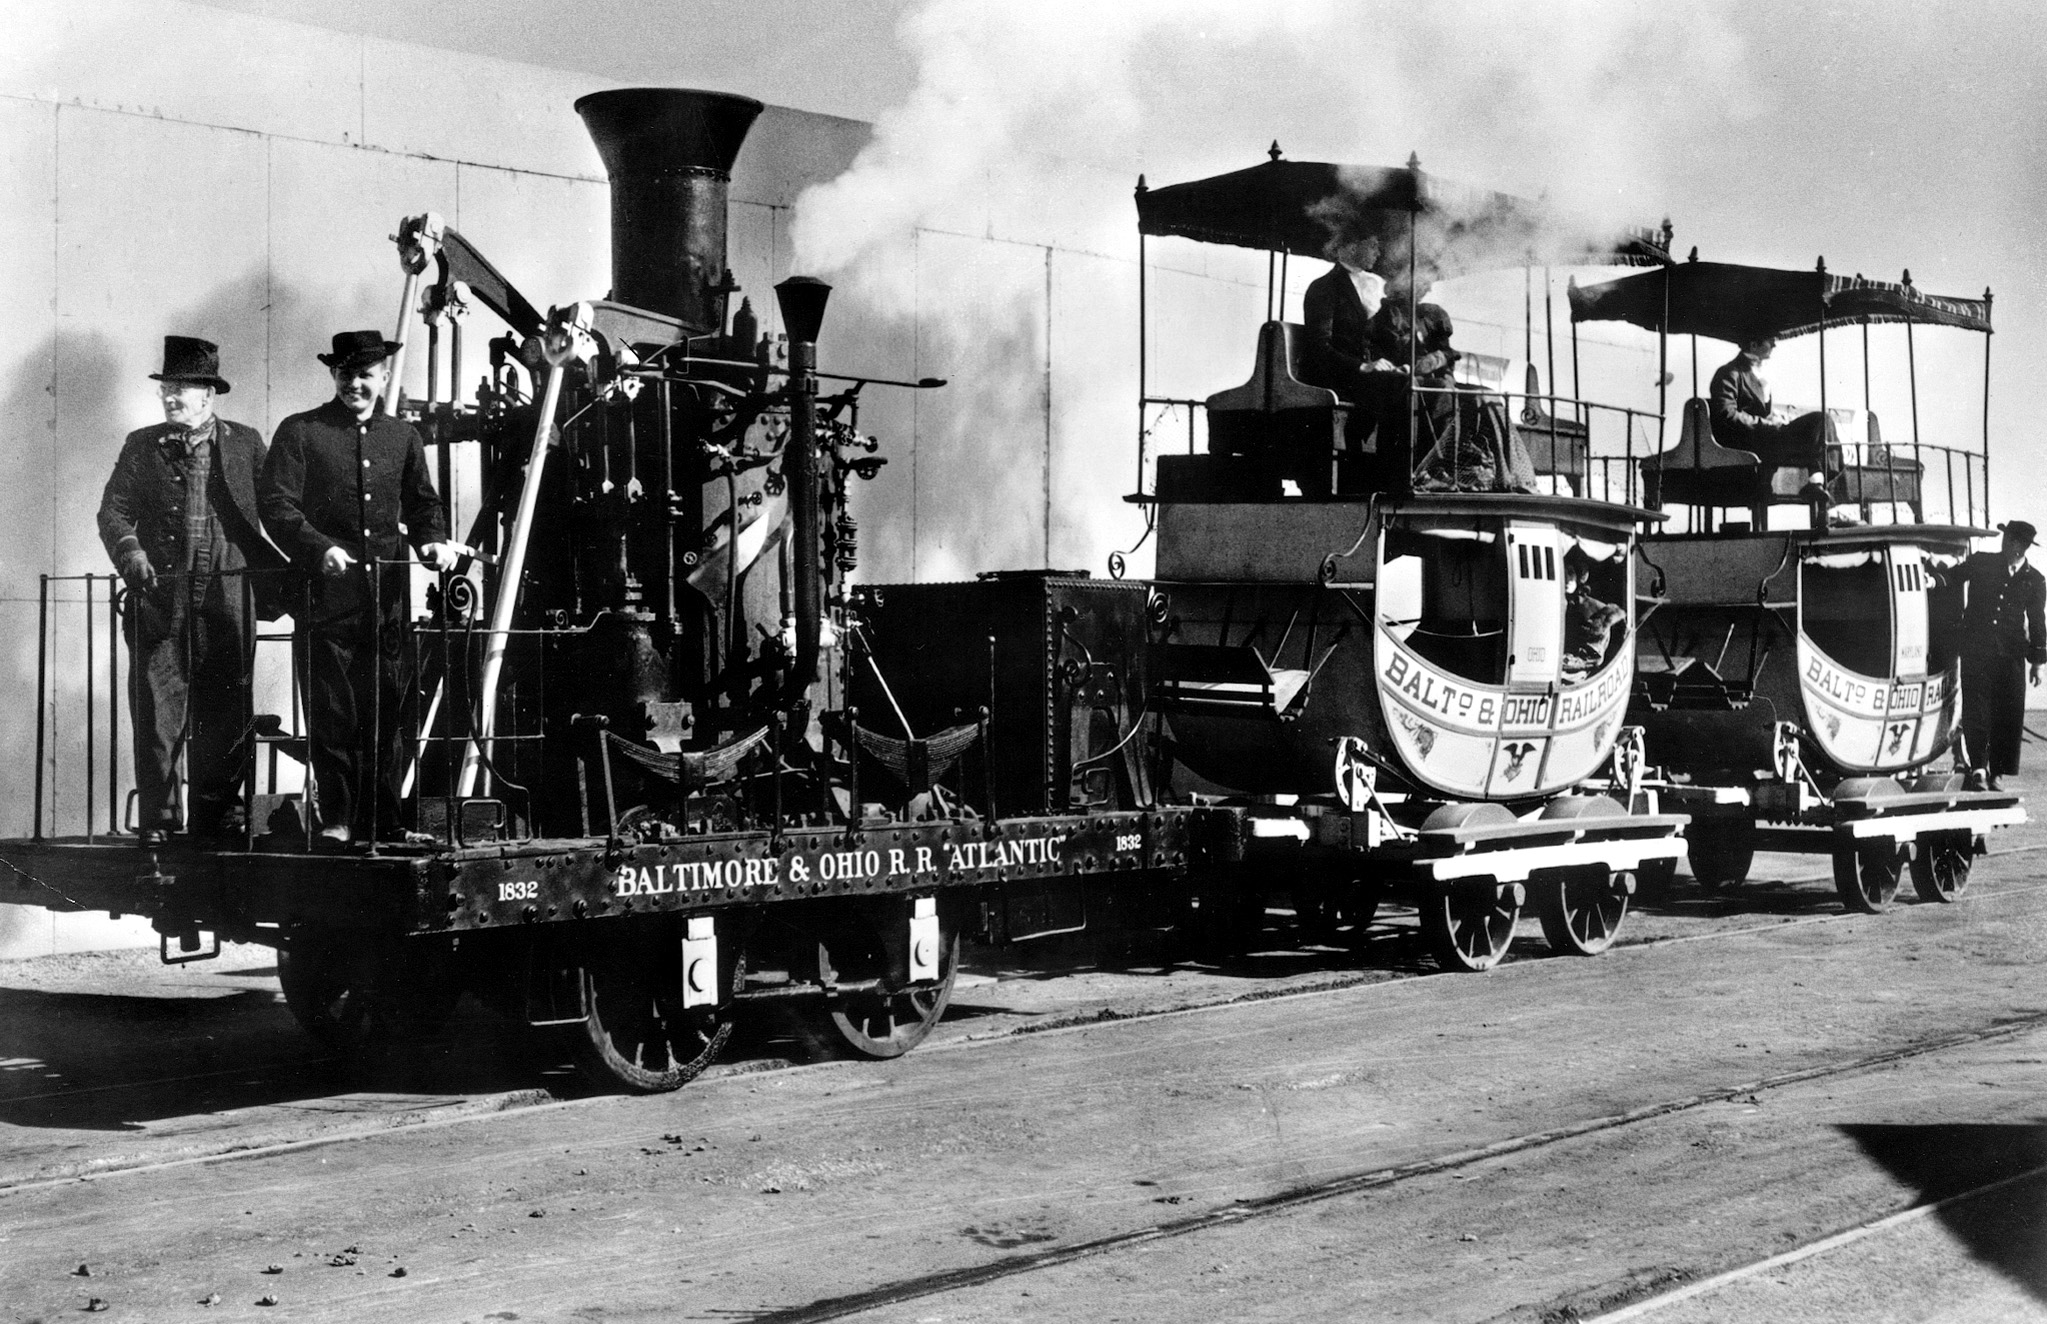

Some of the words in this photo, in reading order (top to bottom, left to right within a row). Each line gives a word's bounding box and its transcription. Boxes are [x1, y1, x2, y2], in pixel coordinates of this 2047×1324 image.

[1477, 698, 1495, 725] &
[1503, 698, 1548, 724] OHIO
[1558, 654, 1629, 724] RAILROAD
[1873, 689, 1885, 710] &
[1889, 687, 1919, 710] OHIO
[1116, 834, 1142, 851] 1832
[615, 857, 780, 898] BALTIMORE
[788, 855, 811, 883] &
[819, 849, 880, 881] OHIO
[498, 881, 539, 902] 1832
